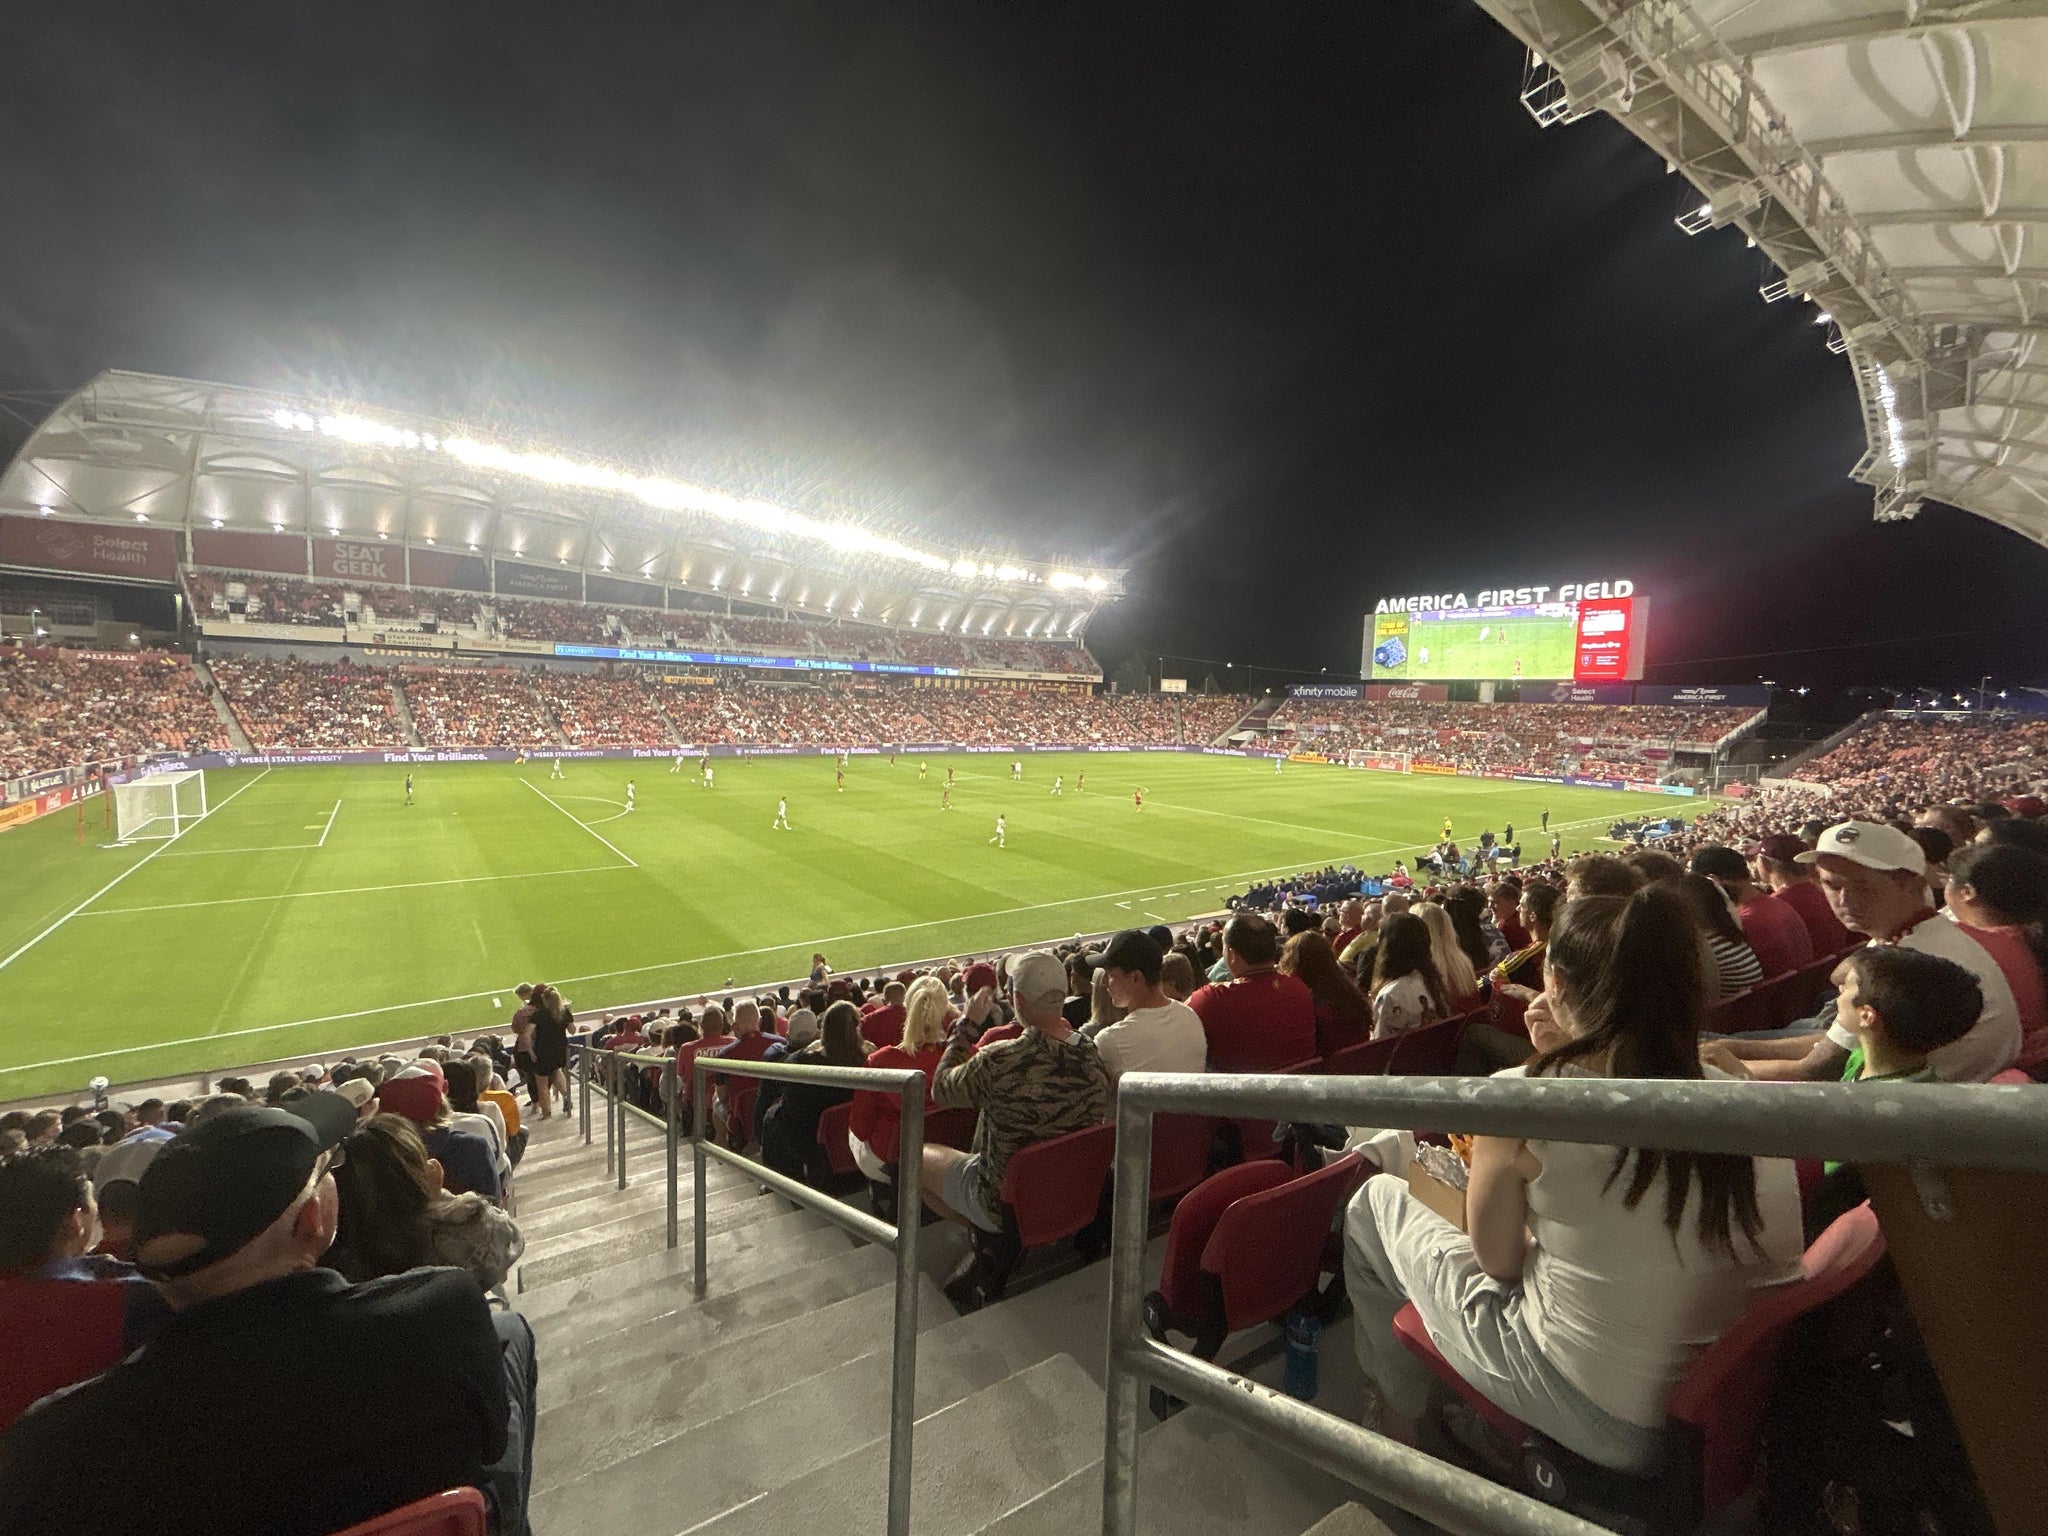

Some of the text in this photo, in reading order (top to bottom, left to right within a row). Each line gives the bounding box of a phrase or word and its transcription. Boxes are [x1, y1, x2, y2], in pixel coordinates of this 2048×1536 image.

[93, 534, 149, 551] Select
[93, 547, 147, 565] Health
[335, 543, 385, 562] SEAT
[333, 560, 388, 578] GEEK
[509, 579, 545, 589] AMERICA
[1375, 580, 1634, 614] AMERICA FIRST FIELD
[77, 652, 104, 660] SALT
[619, 650, 693, 662] Find Your Brilliance.
[1293, 686, 1358, 698] xfinity mobile
[1571, 694, 1594, 702] Health
[573, 750, 604, 758] UNIVERSITY
[633, 749, 651, 757] Find
[652, 749, 671, 757] Your
[820, 747, 835, 755] Find
[850, 747, 881, 755] Brilliance.
[240, 754, 342, 764] WEBER STATE UNIVERSITY
[384, 751, 488, 762] Find Your Brilliance.
[1593, 780, 1613, 788] mobile
